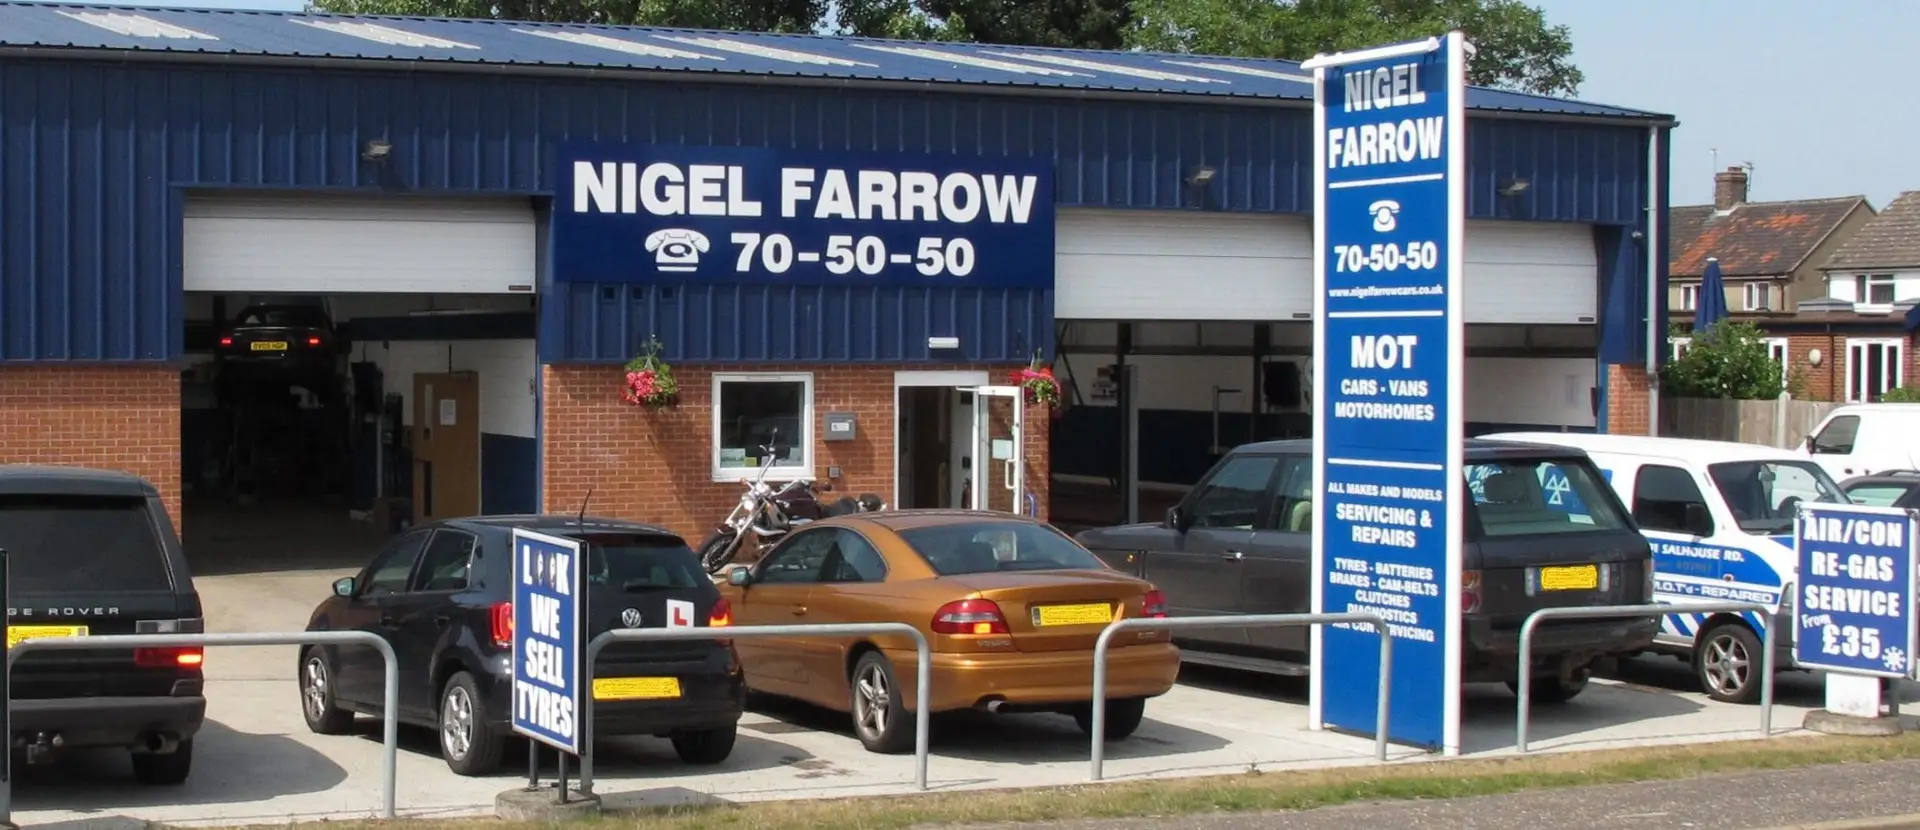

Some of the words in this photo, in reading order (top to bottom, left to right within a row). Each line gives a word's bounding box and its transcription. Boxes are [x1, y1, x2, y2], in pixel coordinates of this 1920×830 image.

[1344, 63, 1426, 112] NIGEL
[1328, 116, 1443, 168] FARROW
[574, 161, 762, 216] NIGEL
[781, 167, 1037, 224] FARROW
[1334, 241, 1437, 272] 70-50-50
[1328, 284, 1443, 299] www.nigelfarrowcars.co.uk
[1351, 335, 1417, 369] MOT
[1341, 379, 1378, 396] CARS
[1388, 380, 1429, 397] VANS
[1335, 402, 1435, 421] MOTORHOMES
[1328, 482, 1345, 494] ALL
[1346, 483, 1379, 497] MAKES
[1380, 485, 1401, 498] AND
[1402, 487, 1443, 501] MODELS
[1336, 503, 1417, 526] SERVICING
[1420, 509, 1432, 528] &
[1352, 525, 1416, 548] REPAIRS
[1804, 517, 1903, 547] AIR/CON
[1661, 543, 1720, 560] SALHOUSE
[1723, 550, 1744, 562] RD.
[1334, 557, 1368, 572] TYRES
[1375, 562, 1433, 581] BATTERIES
[1811, 551, 1894, 582] RE-GAS
[1330, 571, 1370, 588] BRAKES
[1378, 577, 1438, 597] CAM-BELTS
[1701, 586, 1774, 603] REPAIRED
[48, 606, 120, 616] ROVER
[1355, 589, 1410, 608] CLUTCHES
[1805, 584, 1900, 617] SERVICE
[530, 592, 560, 640] WE
[674, 606, 688, 626] L
[1801, 613, 1832, 629] From
[1376, 624, 1435, 642] RVICING
[1822, 624, 1880, 660] £35
[525, 637, 565, 688] SELL
[516, 679, 573, 738] TYRES
